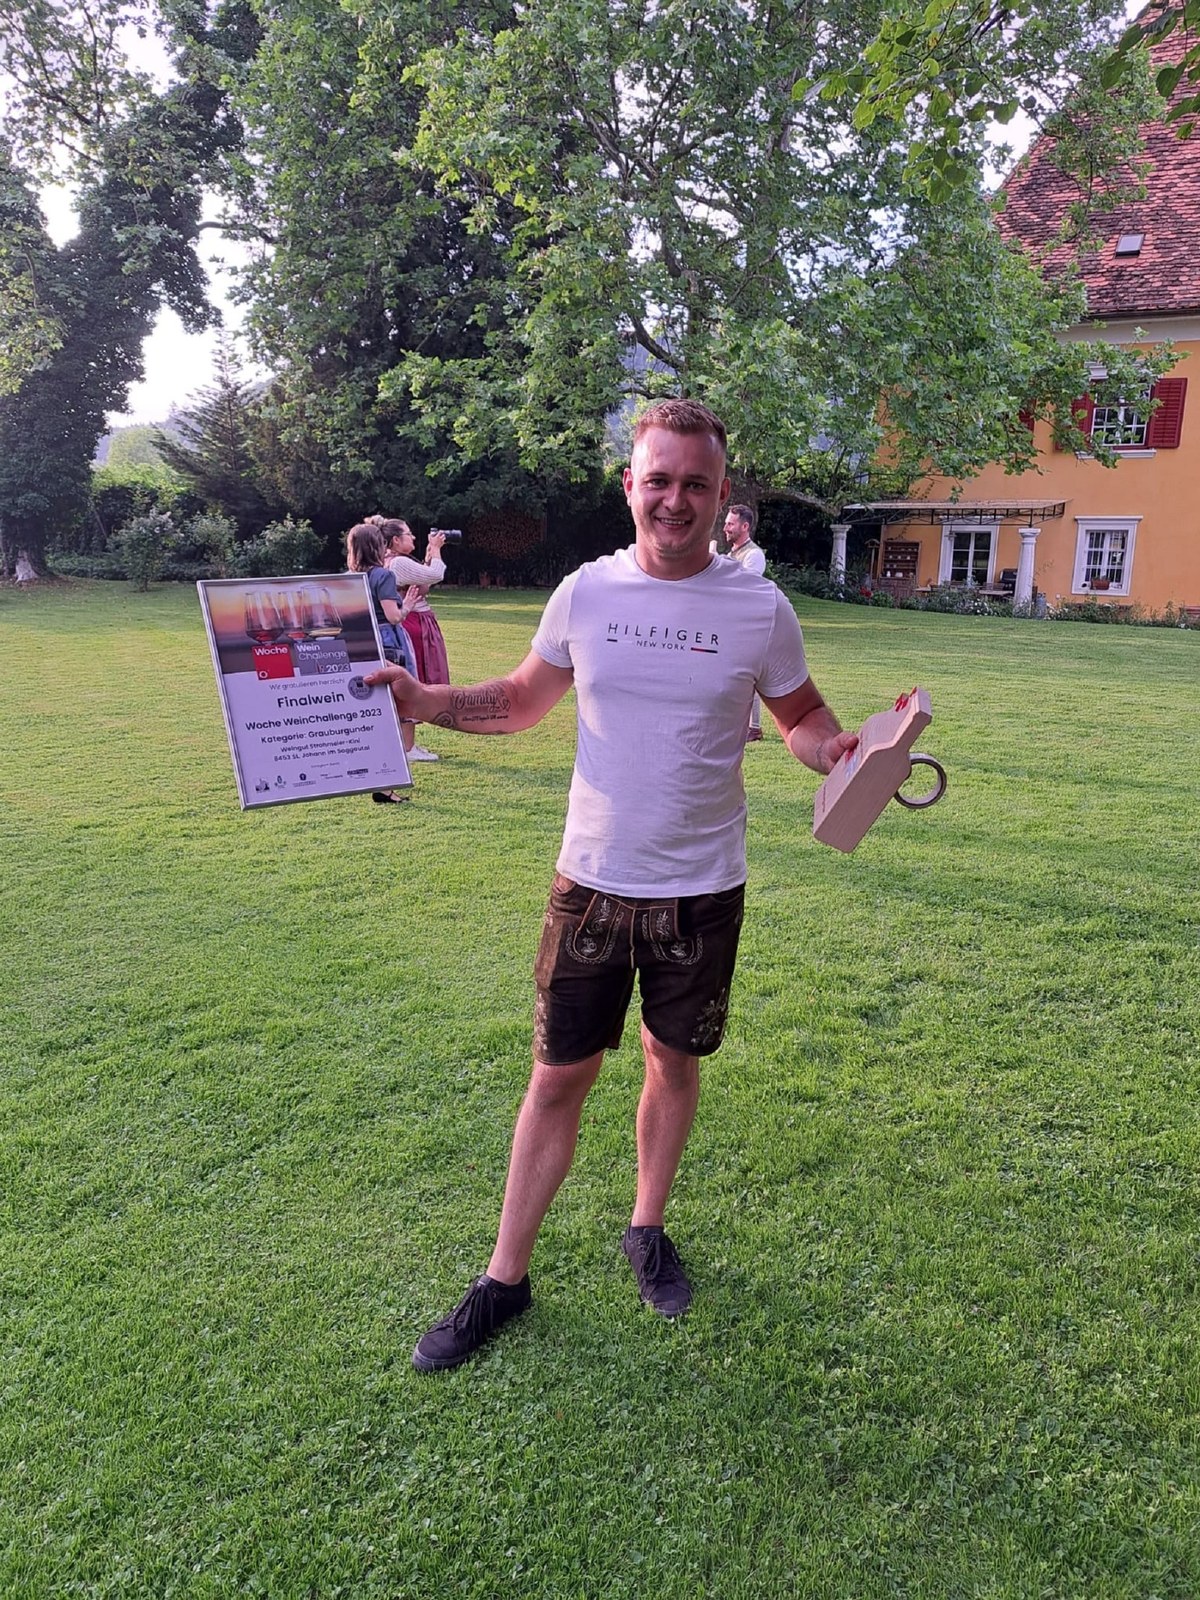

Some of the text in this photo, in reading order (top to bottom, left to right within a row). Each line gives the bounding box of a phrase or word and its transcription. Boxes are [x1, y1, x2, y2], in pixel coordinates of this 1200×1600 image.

[607, 622, 719, 645] HILFIGER
[254, 646, 288, 656] Woche
[296, 643, 321, 652] Wein
[636, 640, 686, 651] NEW YORK
[298, 650, 347, 661] Challenge
[326, 664, 350, 673] 2023
[277, 691, 345, 708] Finalwein
[244, 708, 382, 731] Woche WeinChallenge 2023
[261, 725, 375, 744] Kategorie: Grauburgunder
[280, 744, 309, 753] Weingut
